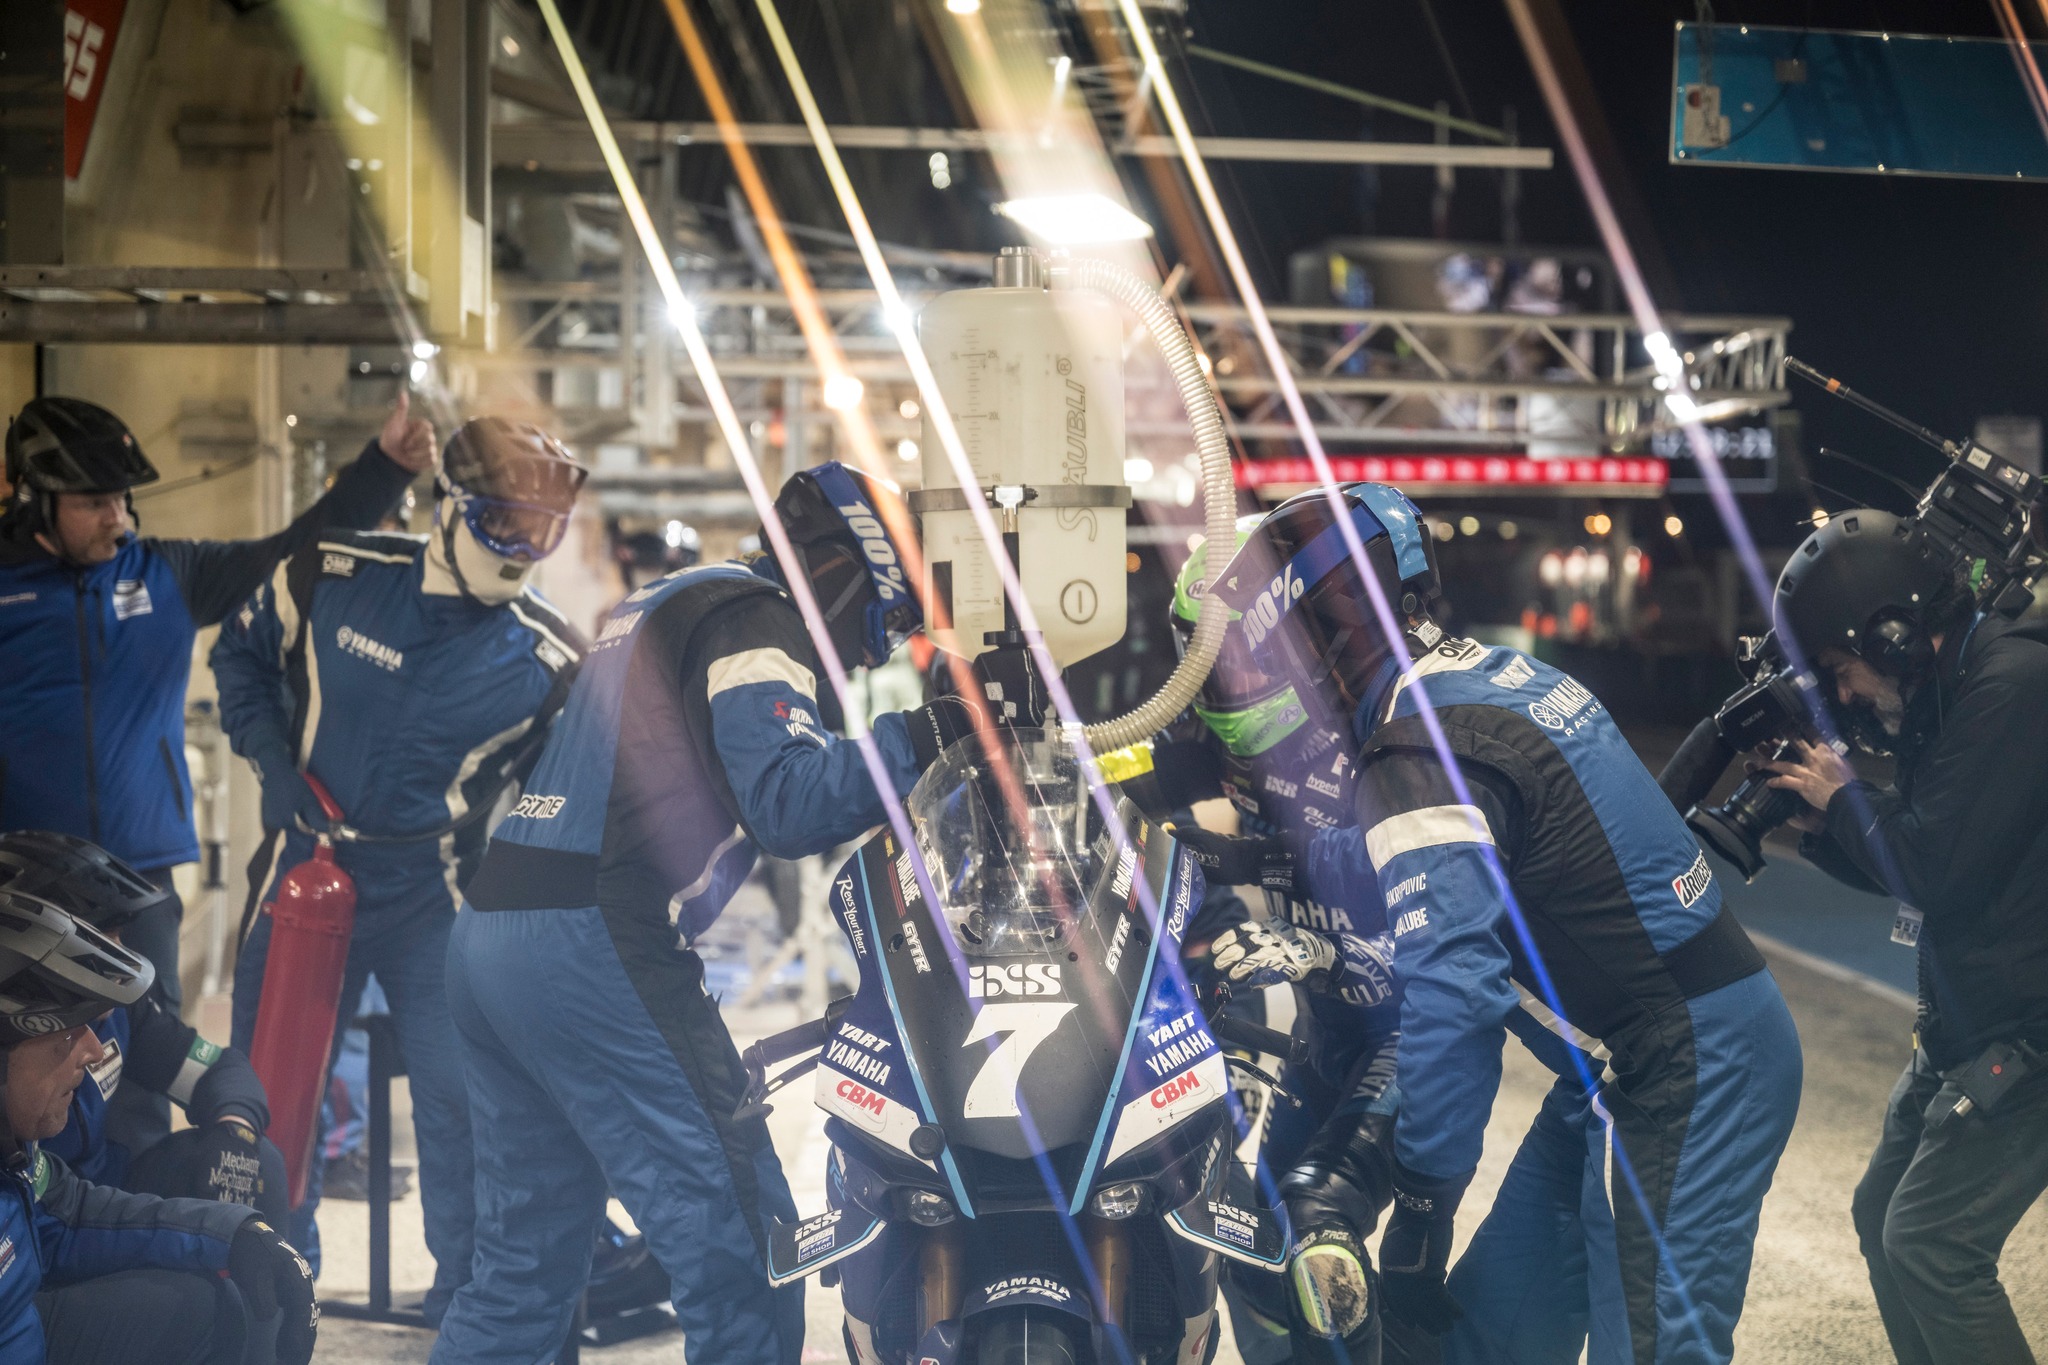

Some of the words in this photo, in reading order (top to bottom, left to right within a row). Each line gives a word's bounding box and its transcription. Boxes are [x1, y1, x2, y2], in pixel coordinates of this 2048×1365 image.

[1057, 378, 1098, 542] SÄUBLI
[838, 501, 906, 600] 100%
[1243, 563, 1304, 651] 100%
[353, 631, 403, 669] YAMAHA
[1541, 675, 1594, 719] YAMAHA
[1564, 702, 1602, 737] RACING
[1304, 815, 1329, 830] CR
[896, 848, 921, 907] YAMALUBE
[1111, 840, 1138, 900] YAMALUBE
[902, 920, 931, 974] GYTR
[1104, 912, 1131, 976] GYTR
[838, 1022, 892, 1053] YART
[1147, 1011, 1195, 1048] YART
[826, 1039, 892, 1086] YAMAHA
[961, 1002, 1079, 1118] 7
[1145, 1029, 1215, 1077] YAMAHA
[836, 1079, 887, 1116] CBM
[1151, 1071, 1200, 1109] CBM
[811, 1241, 832, 1254] SHOP
[1229, 1234, 1251, 1245] SHOP
[984, 1276, 1071, 1299] YAMAHA
[986, 1286, 1067, 1304] GYTR
